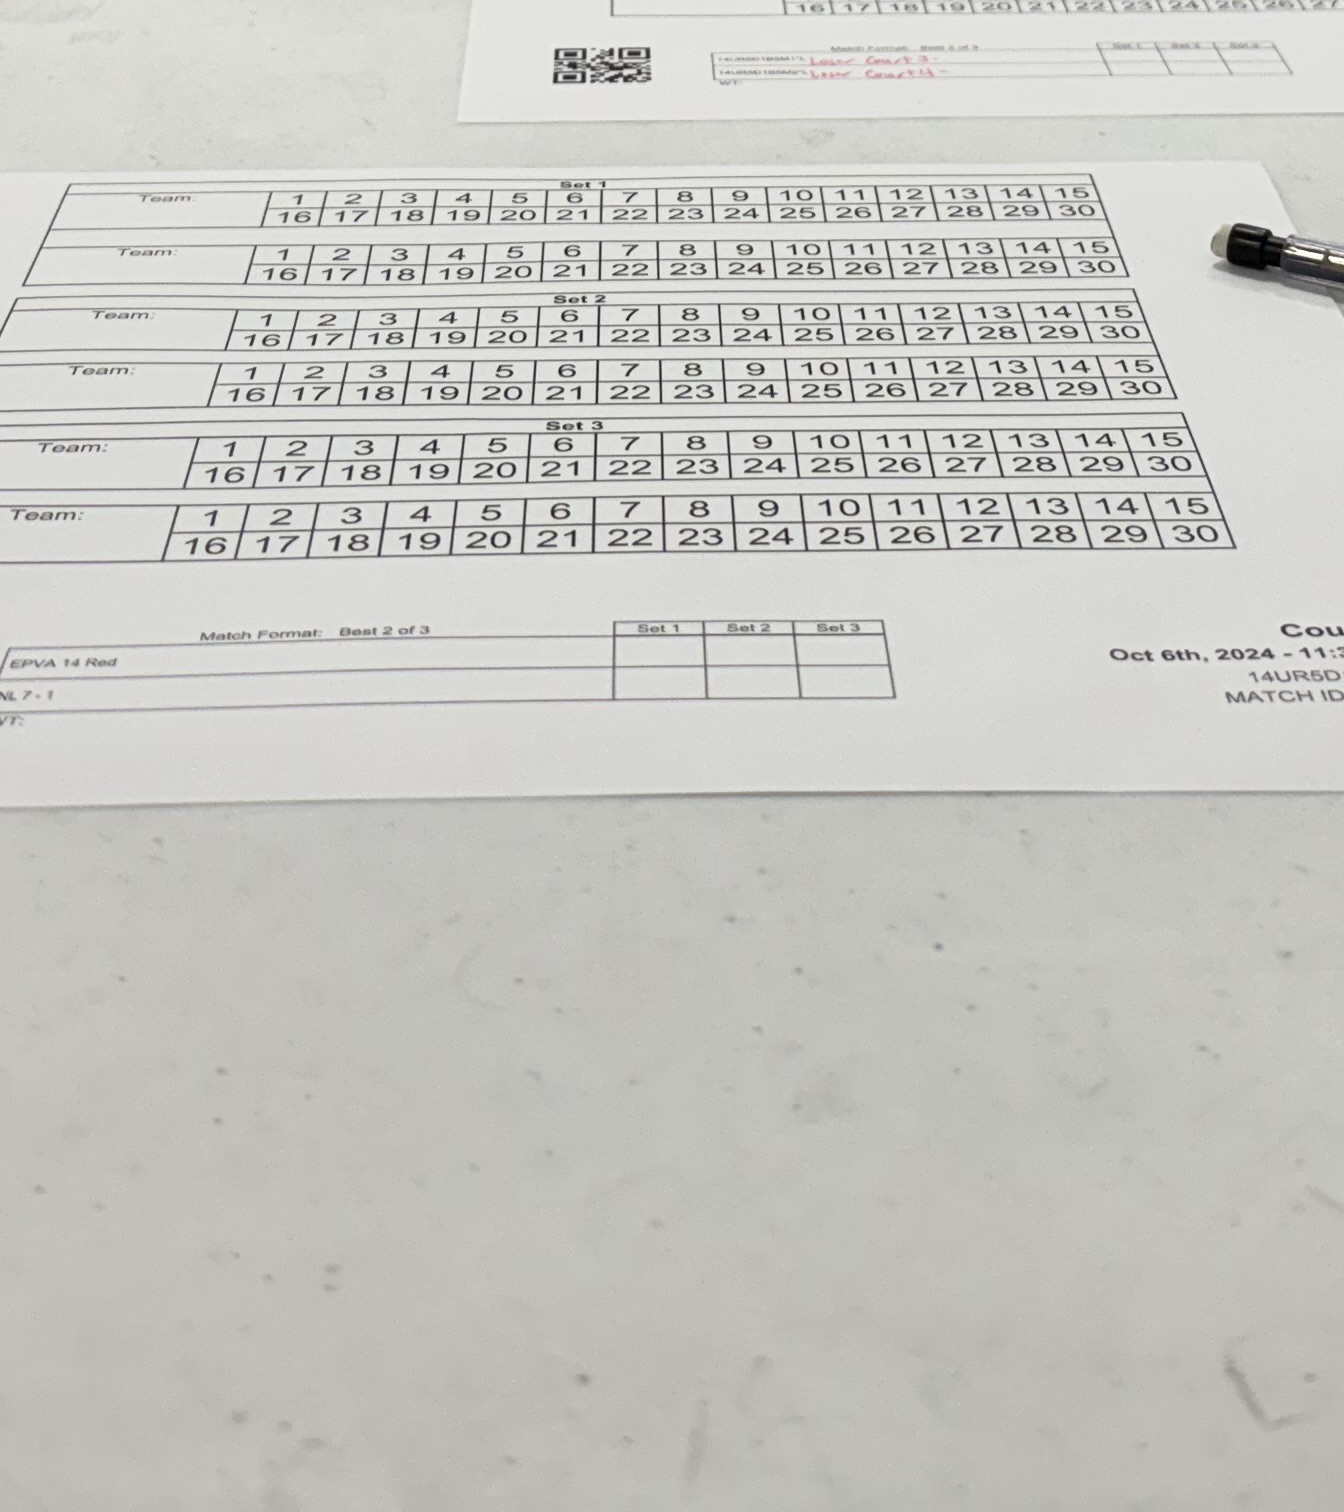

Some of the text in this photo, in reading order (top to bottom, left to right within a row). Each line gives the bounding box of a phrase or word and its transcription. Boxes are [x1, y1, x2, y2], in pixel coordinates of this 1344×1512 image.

[279, 204, 1095, 223] 16 17 18 19 20 21 22 23 24 25 26 27 28 29 30
[118, 248, 178, 256] Team:
[554, 294, 606, 304] Set 2
[92, 310, 156, 320] Team:
[68, 366, 136, 376] Team:
[547, 420, 603, 430] Set 3
[38, 442, 108, 453] Team:
[224, 432, 1183, 457] 1 2 3 4 5 6 7 8 9 10 11 12 13 14 15
[205, 456, 1192, 483] 16 17 18 19 20 21 22 23 24 25 26 27 28 29 30
[11, 509, 84, 521] Team:
[204, 497, 1209, 526] 1 2 3 4 5 6 7 8 9 10 11 12 13 14 15
[185, 525, 1218, 555] 16 17 18 19 20 21 22 23 24 25 26 27 28 29 30
[637, 624, 666, 633] Set
[727, 623, 771, 632] Set 2
[817, 623, 860, 632] Set 3
[200, 626, 430, 641] Match Format: Best 2 of 3
[1109, 648, 1154, 662] Oct
[1161, 649, 1208, 662] 6th,
[1215, 648, 1275, 661] 2024
[10, 658, 118, 669] EPVA 14 Red
[22, 690, 32, 700] 7
[1225, 690, 1314, 704] MATCH
